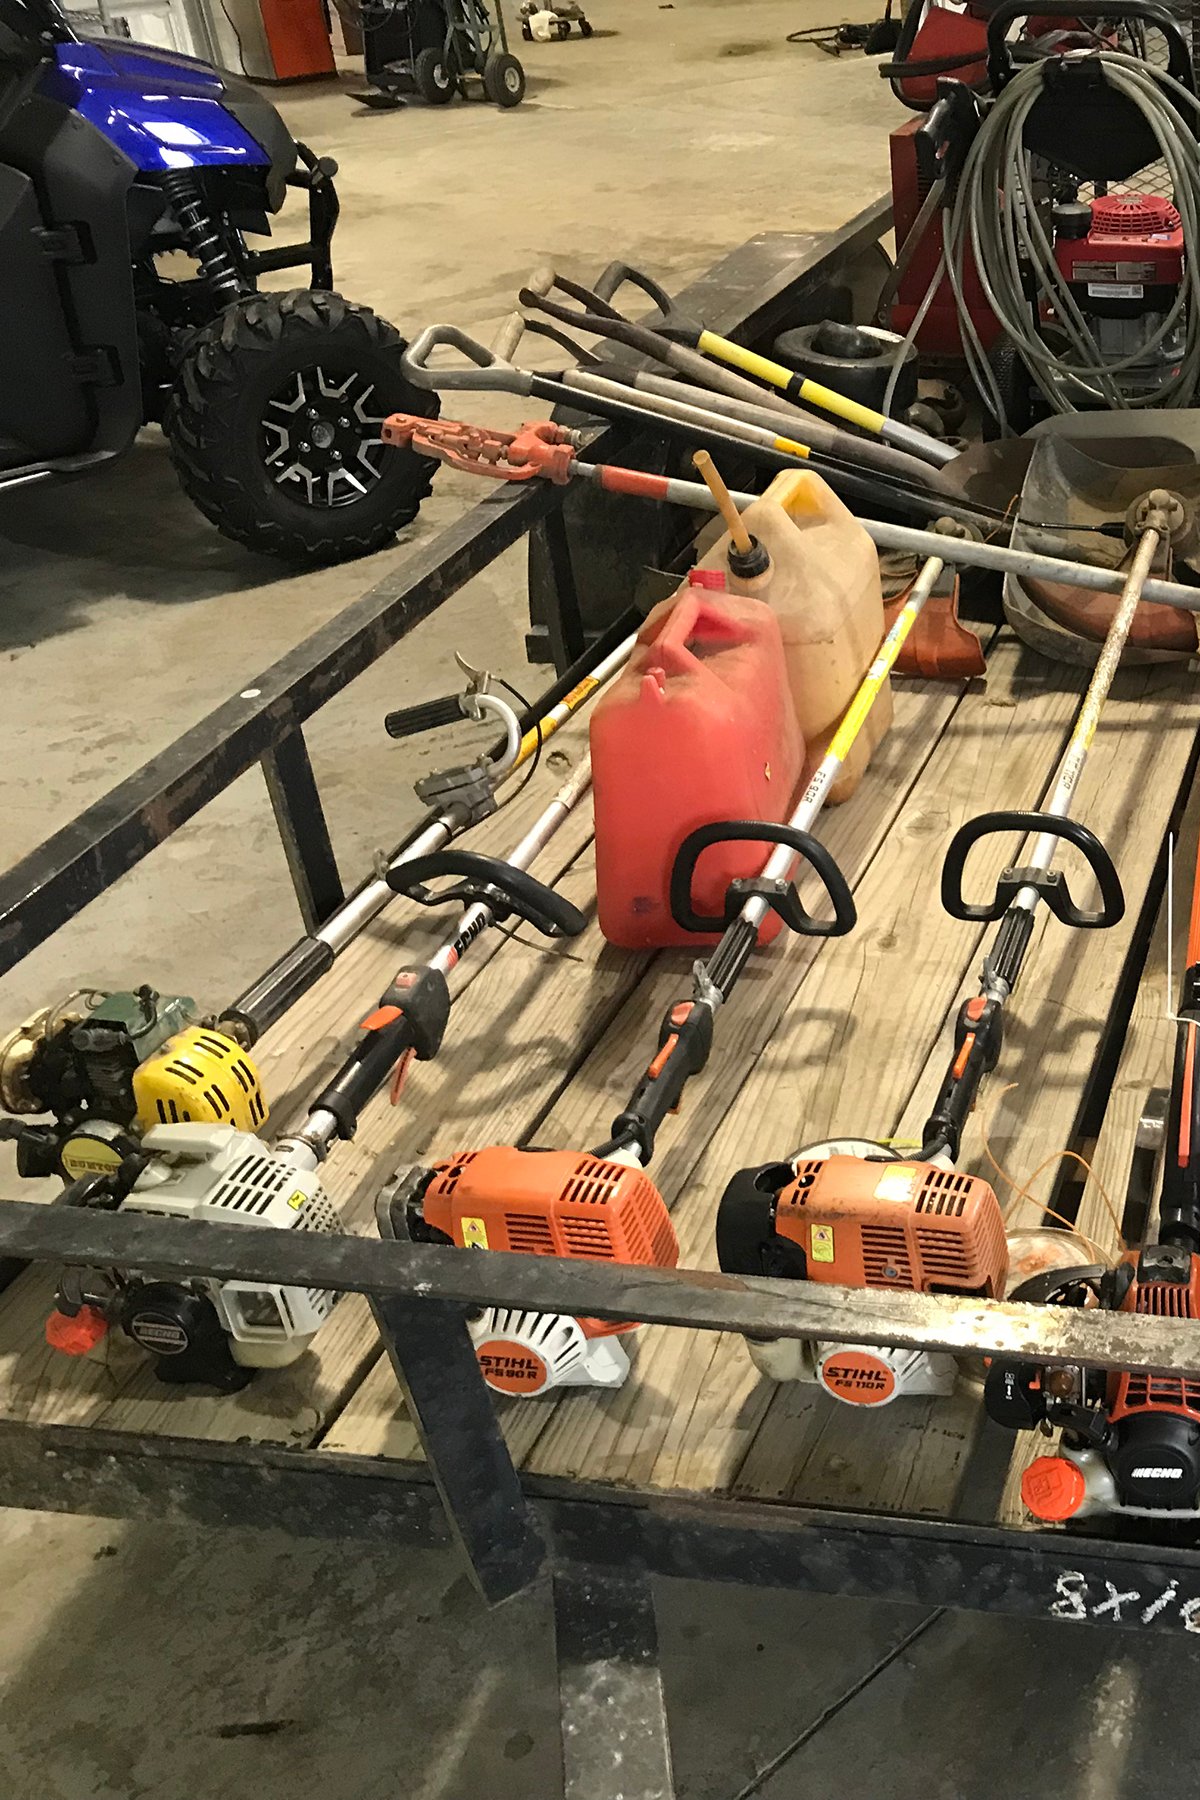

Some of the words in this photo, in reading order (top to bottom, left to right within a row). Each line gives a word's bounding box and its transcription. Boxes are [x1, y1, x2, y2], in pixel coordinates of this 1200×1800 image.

[480, 1355, 539, 1370] STIHL
[484, 1367, 504, 1377] FS
[825, 1366, 887, 1382] STIHL
[835, 1379, 852, 1388] FS
[1136, 1467, 1183, 1479] ECHO
